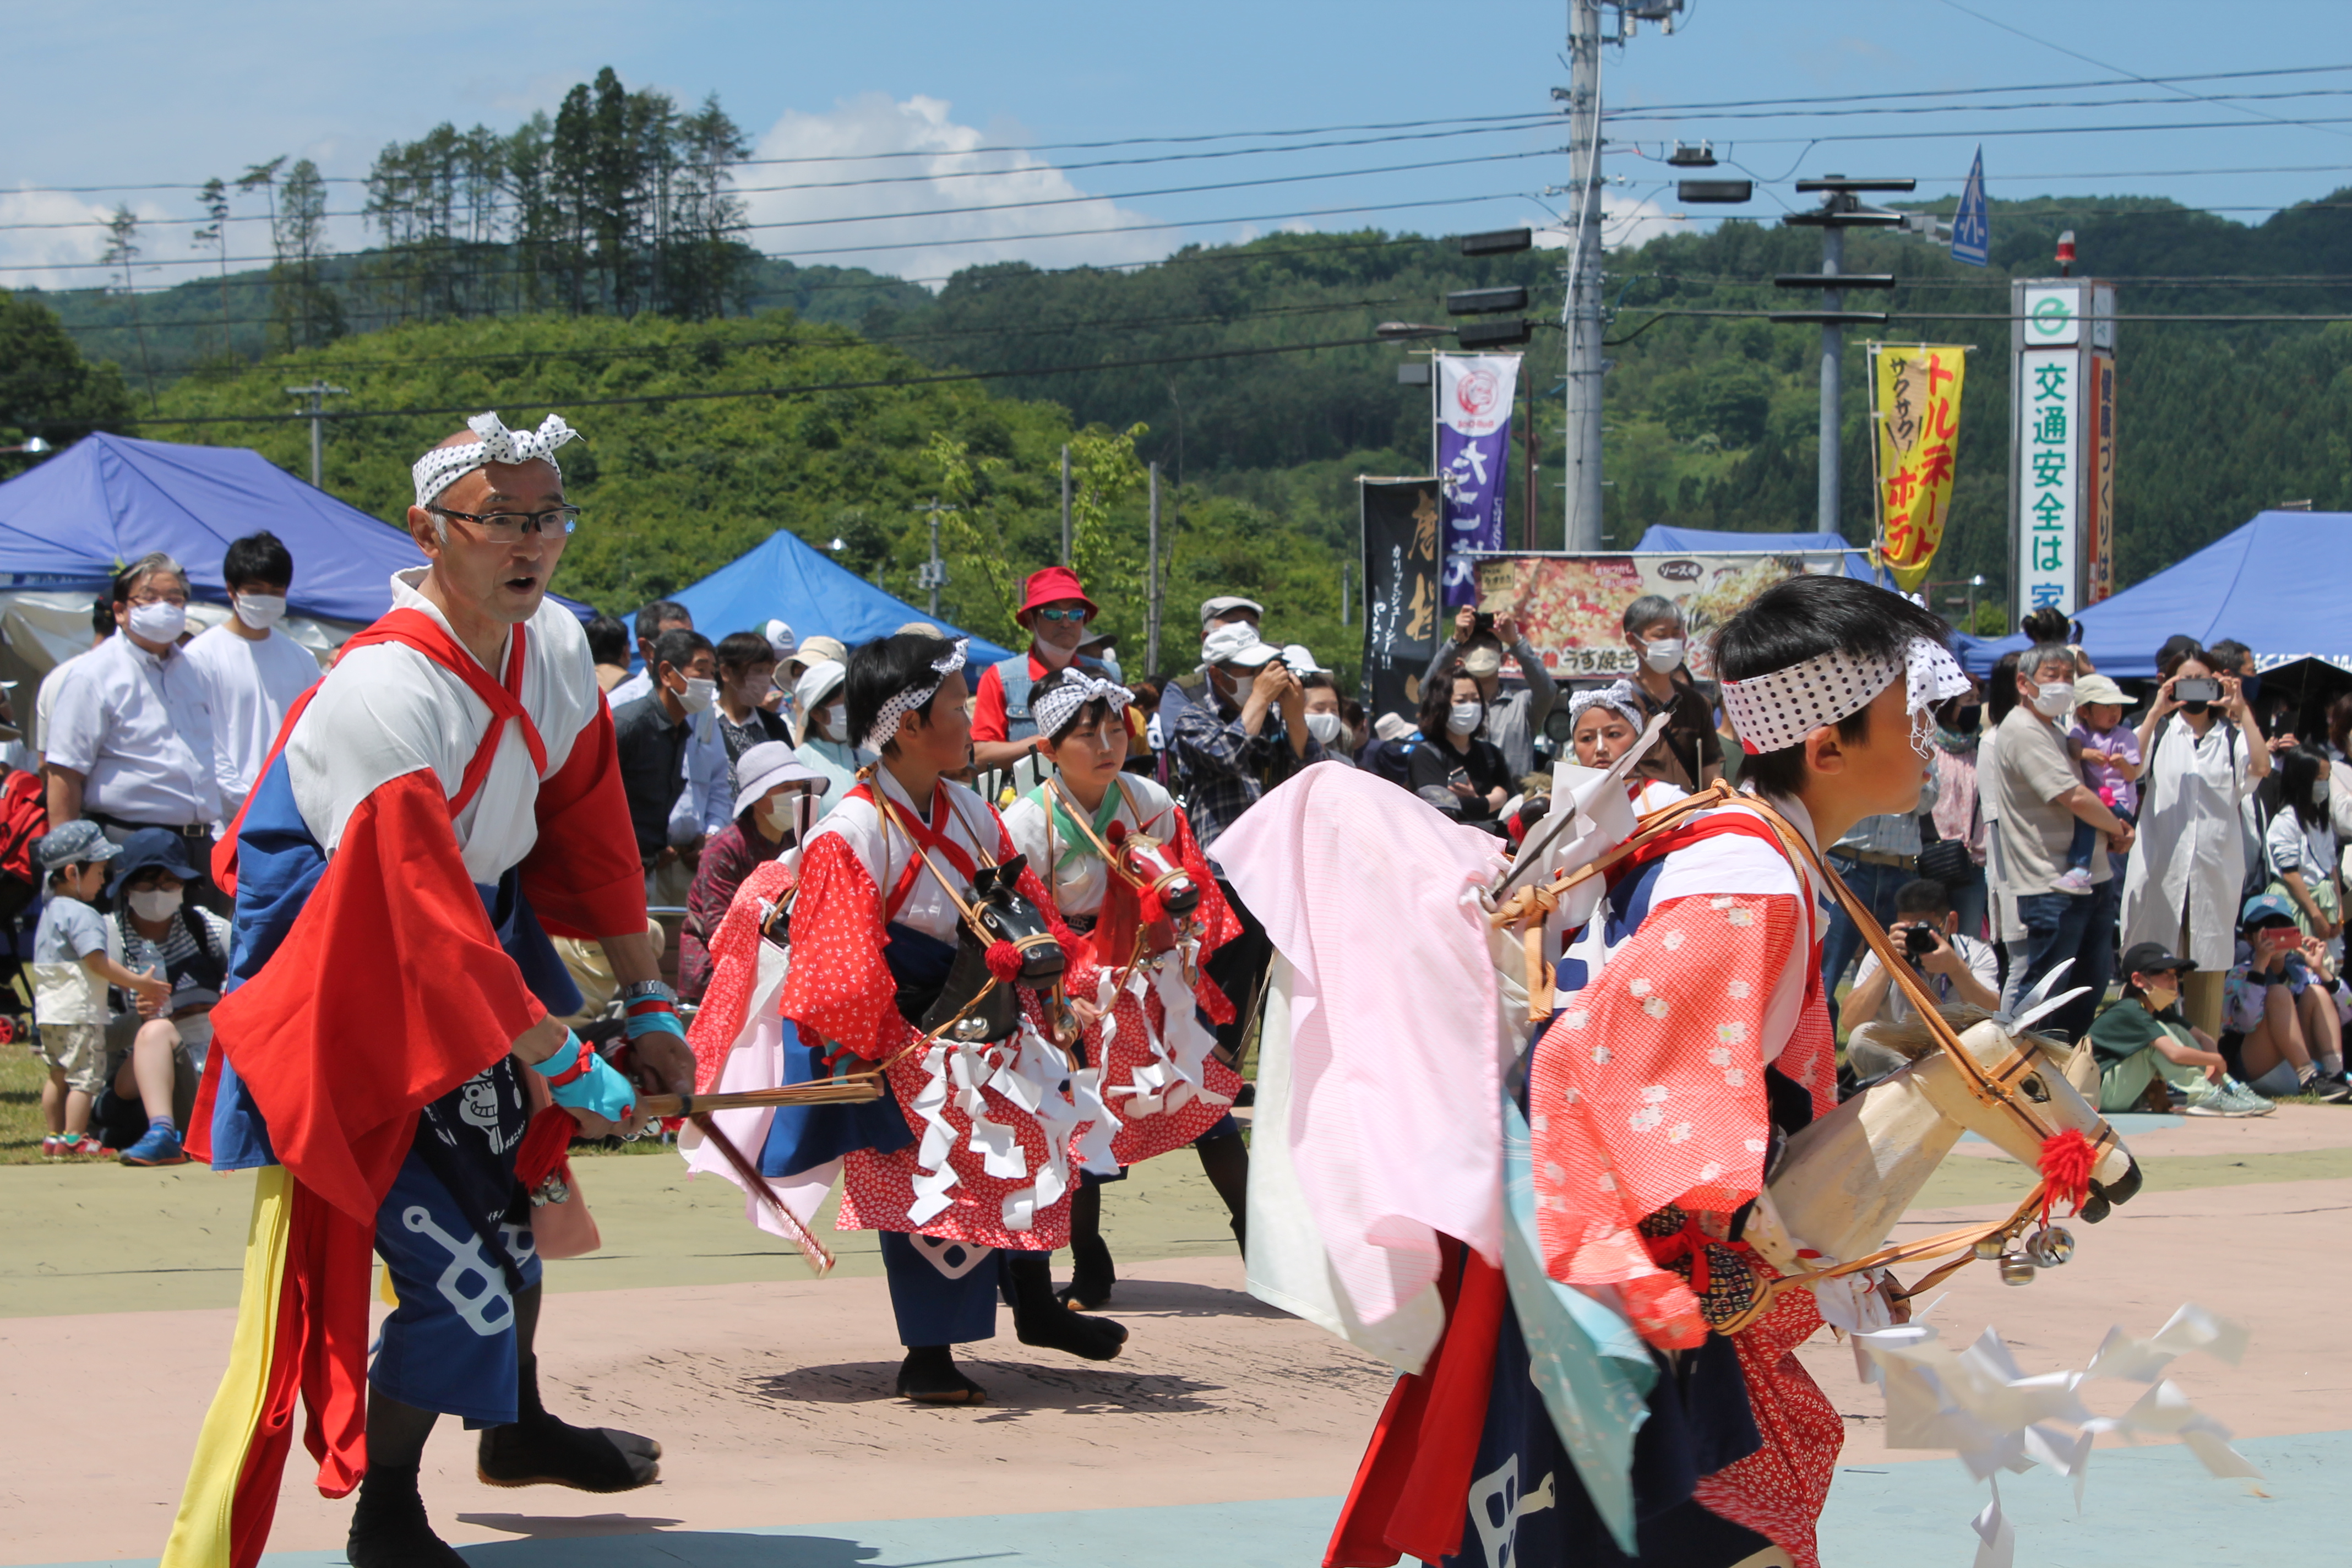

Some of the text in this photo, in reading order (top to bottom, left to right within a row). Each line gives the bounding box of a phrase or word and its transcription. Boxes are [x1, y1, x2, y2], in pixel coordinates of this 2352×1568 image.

[1911, 353, 1957, 565] トルネード
[1881, 465, 1918, 556] ポテ
[1564, 648, 1638, 671] うす焼き
